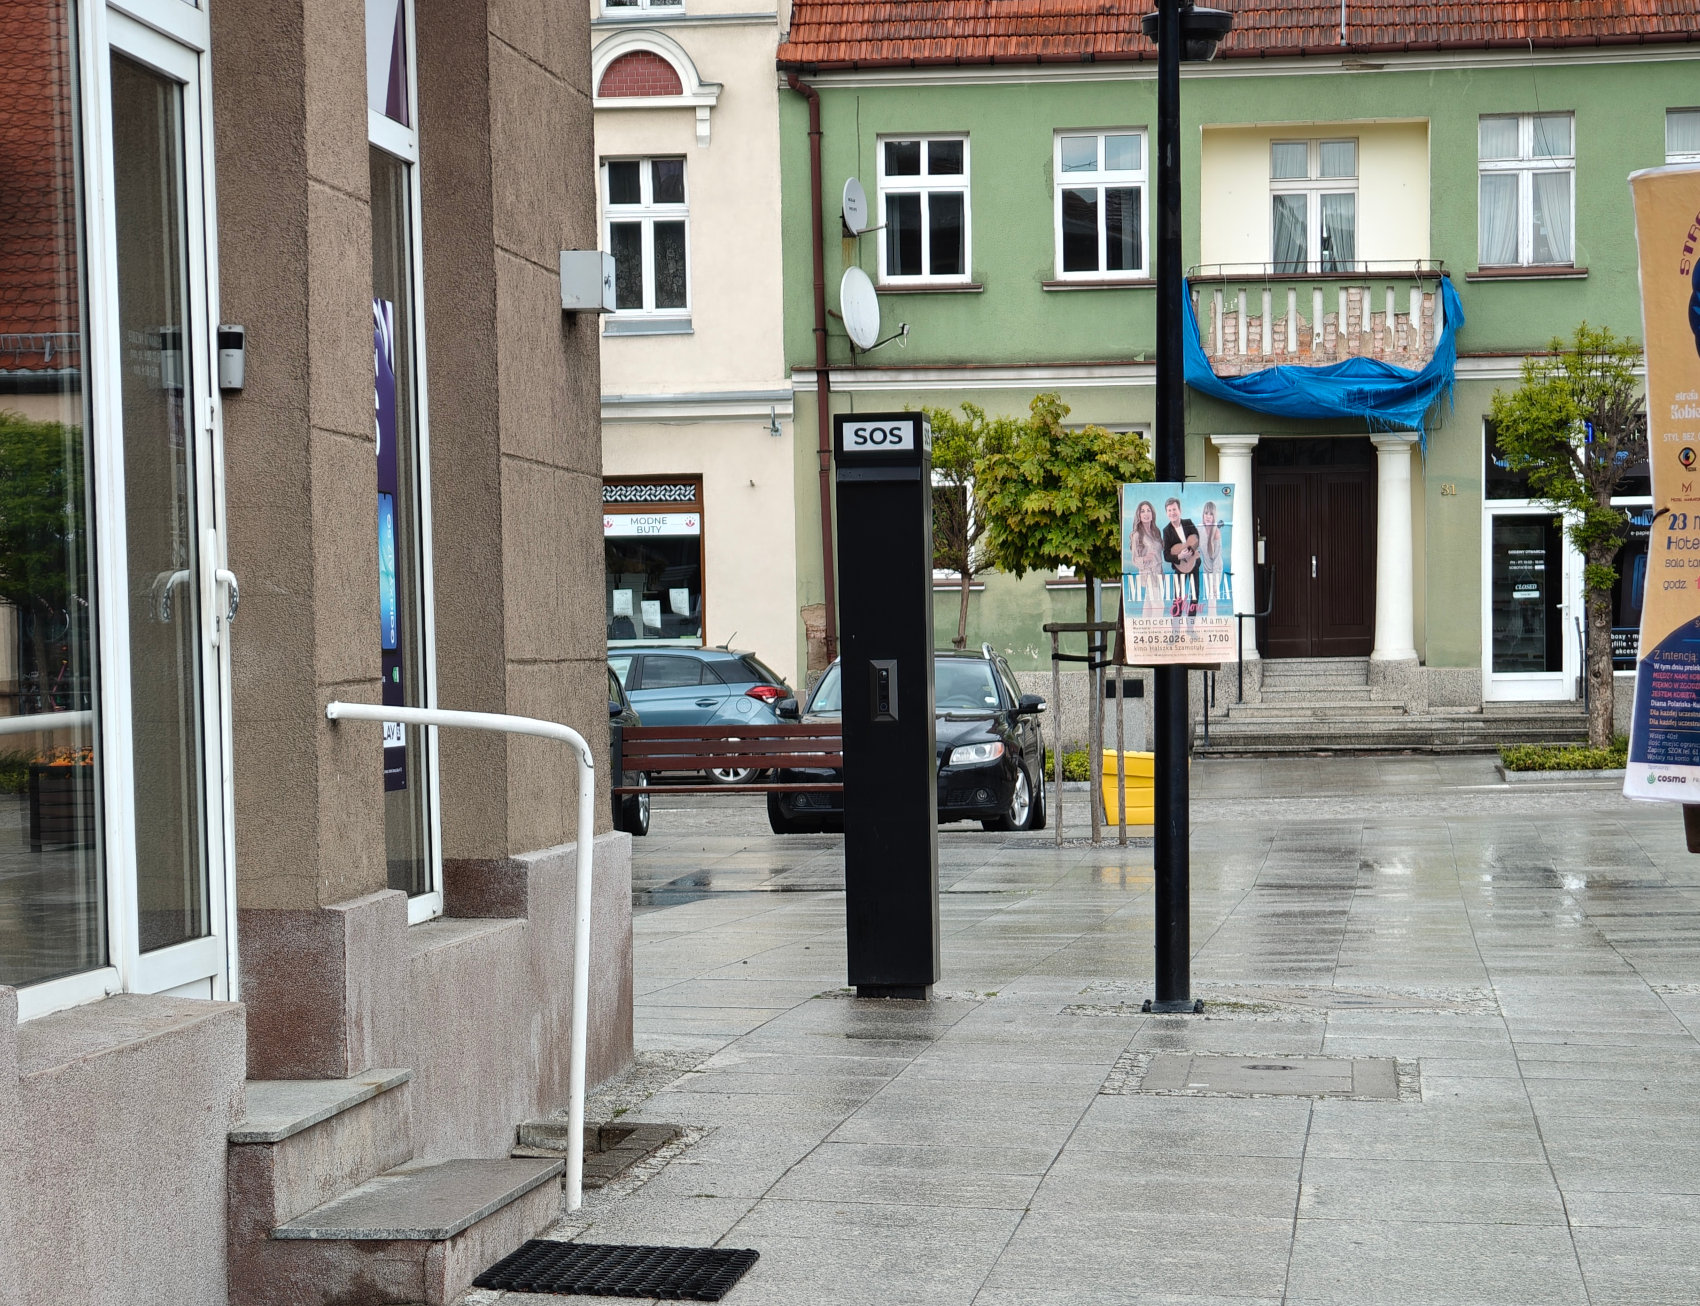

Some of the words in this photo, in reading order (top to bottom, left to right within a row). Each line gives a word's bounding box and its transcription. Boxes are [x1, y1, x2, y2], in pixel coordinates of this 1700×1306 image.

[853, 427, 903, 445] SOS
[1440, 483, 1456, 496] 31
[630, 517, 667, 525] MODNE
[1668, 513, 1688, 530] 23
[636, 525, 661, 534] BUTY
[1665, 559, 1685, 568] sala
[1127, 573, 1198, 602] MAMMA
[1202, 572, 1232, 600] MIA
[1170, 596, 1206, 617] Show
[1132, 618, 1174, 627] koncert
[1201, 616, 1229, 626] Mamy
[1208, 634, 1230, 643] 17.00
[1654, 650, 1660, 660] Z
[1657, 775, 1687, 783] cosma
